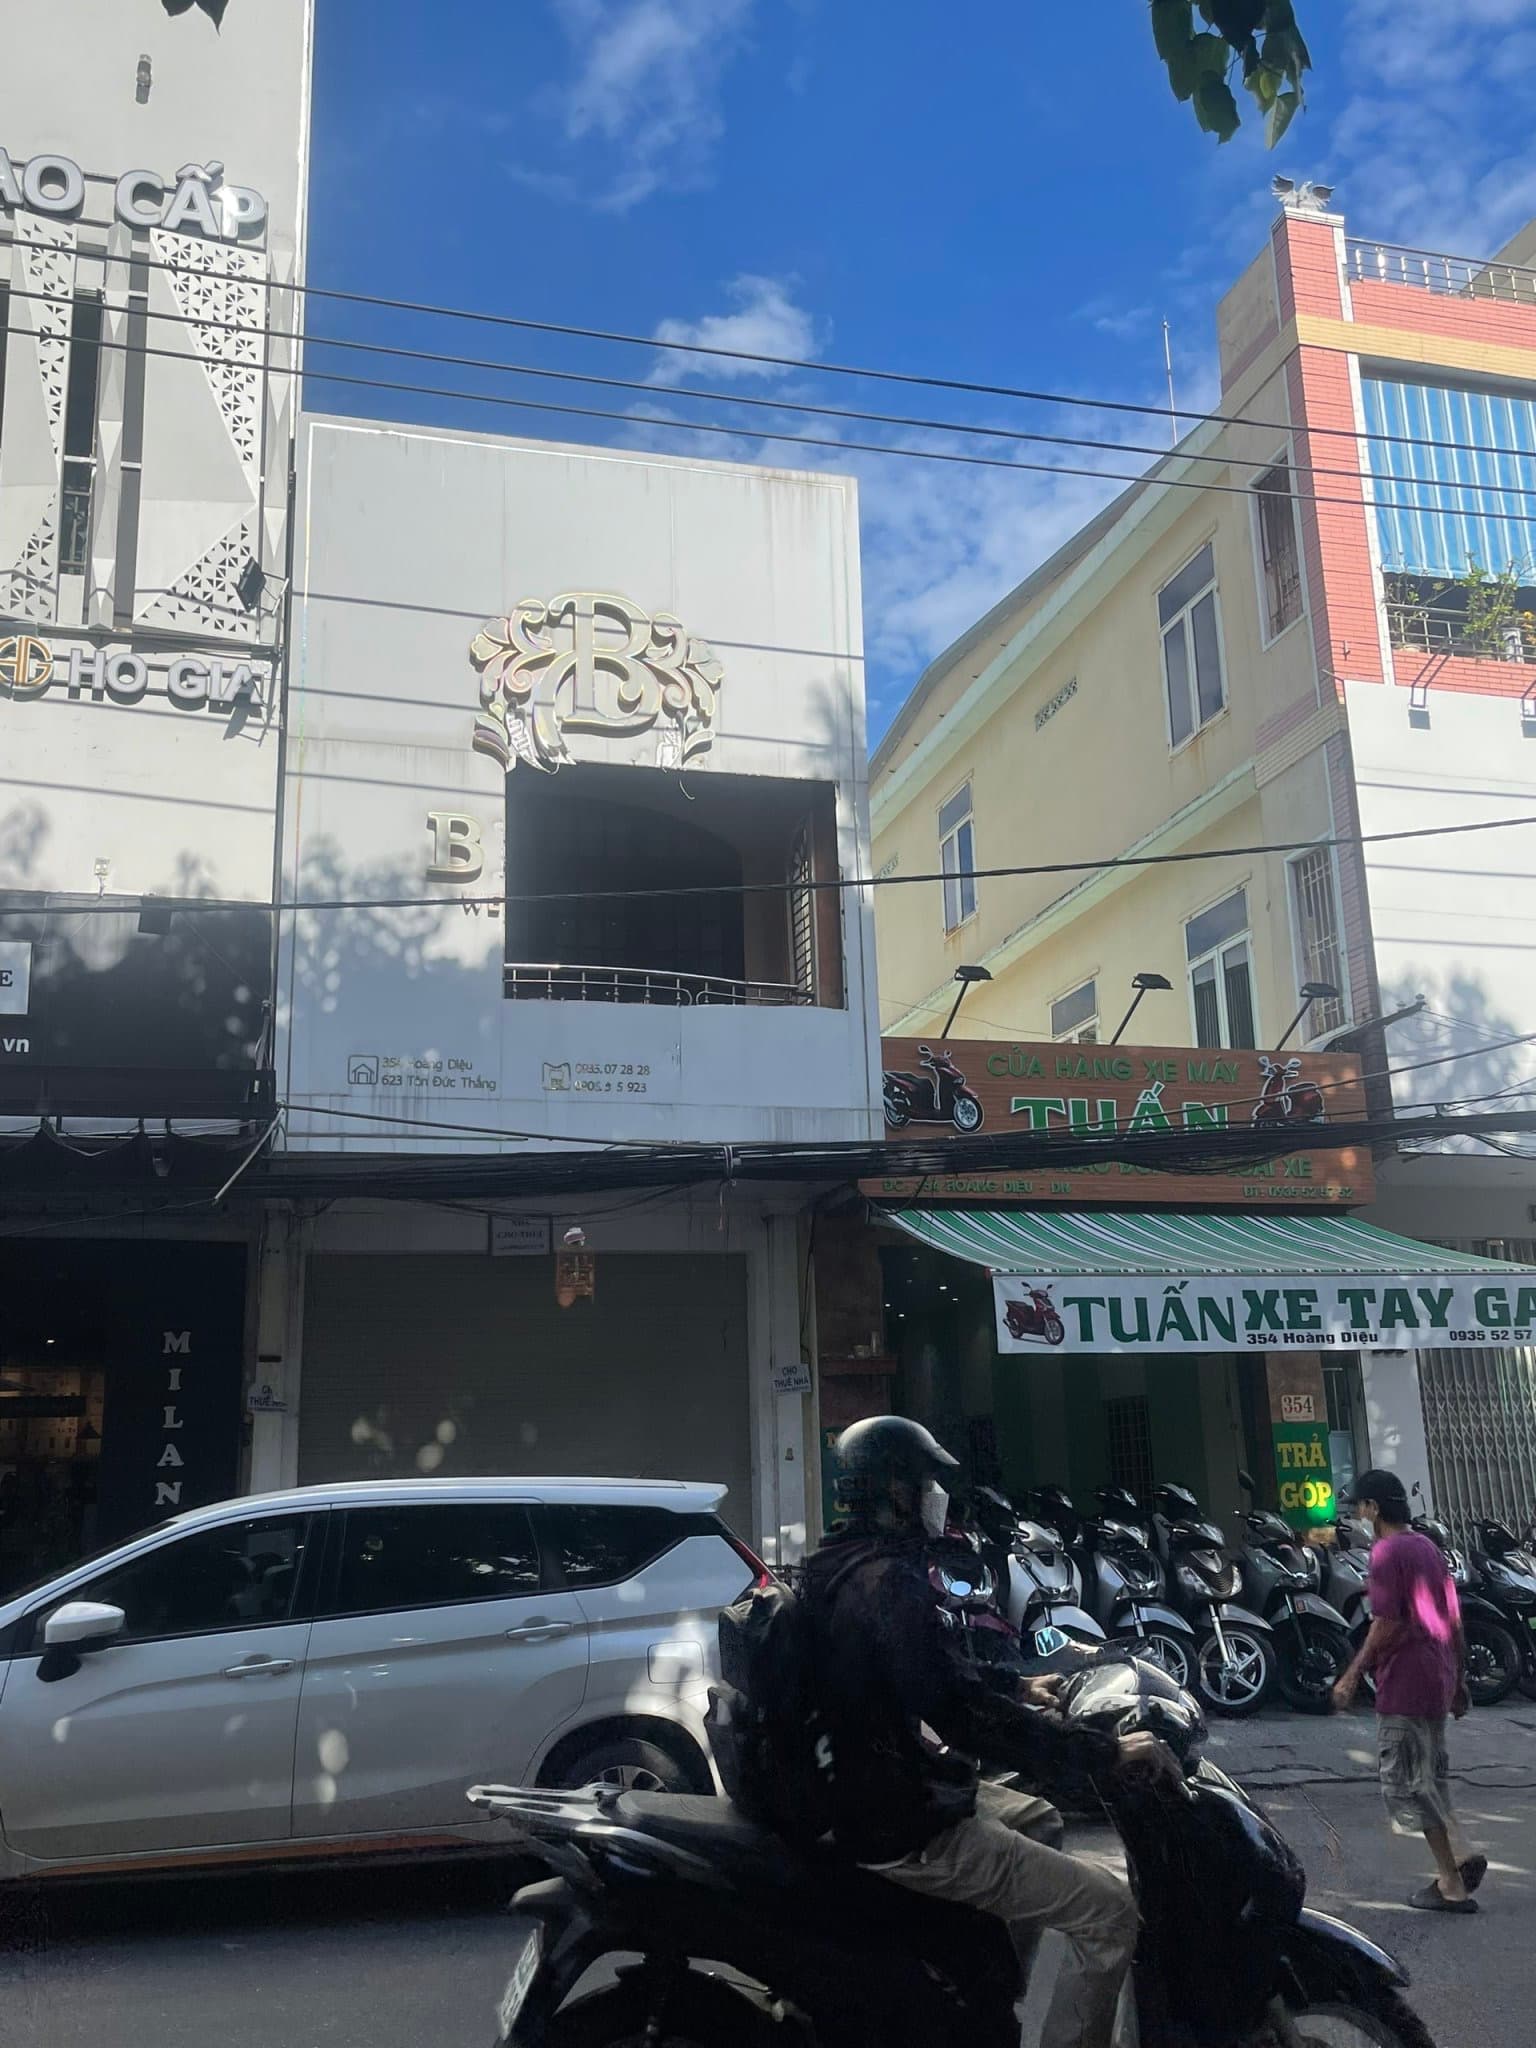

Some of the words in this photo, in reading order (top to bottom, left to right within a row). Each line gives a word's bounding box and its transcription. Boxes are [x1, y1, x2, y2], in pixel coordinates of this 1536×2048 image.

[115, 160, 266, 238] CẤP
[382, 1074, 402, 1086] 623
[637, 1065, 650, 1076] 28
[987, 1046, 1046, 1078] CỬA
[1055, 1052, 1133, 1080] HÀNG
[1143, 1059, 1178, 1083] XE
[1187, 1056, 1240, 1084] MÁY
[1011, 1081, 1229, 1138] TUẤN
[1063, 1281, 1238, 1344] TUẤN
[1242, 1289, 1322, 1330] XE
[1337, 1288, 1454, 1329] TAY
[1474, 1287, 1536, 1329] GA
[1247, 1333, 1278, 1345] 354
[1283, 1331, 1336, 1345] Hoàng
[1341, 1331, 1379, 1343] Diệu
[1450, 1331, 1486, 1342] 0935
[1490, 1331, 1510, 1341] 52
[1514, 1330, 1532, 1340] 57
[155, 1331, 192, 1505] MILAN
[1284, 1396, 1313, 1414] 354
[1277, 1433, 1327, 1468] TRẢ
[1280, 1475, 1332, 1508] GÓP
